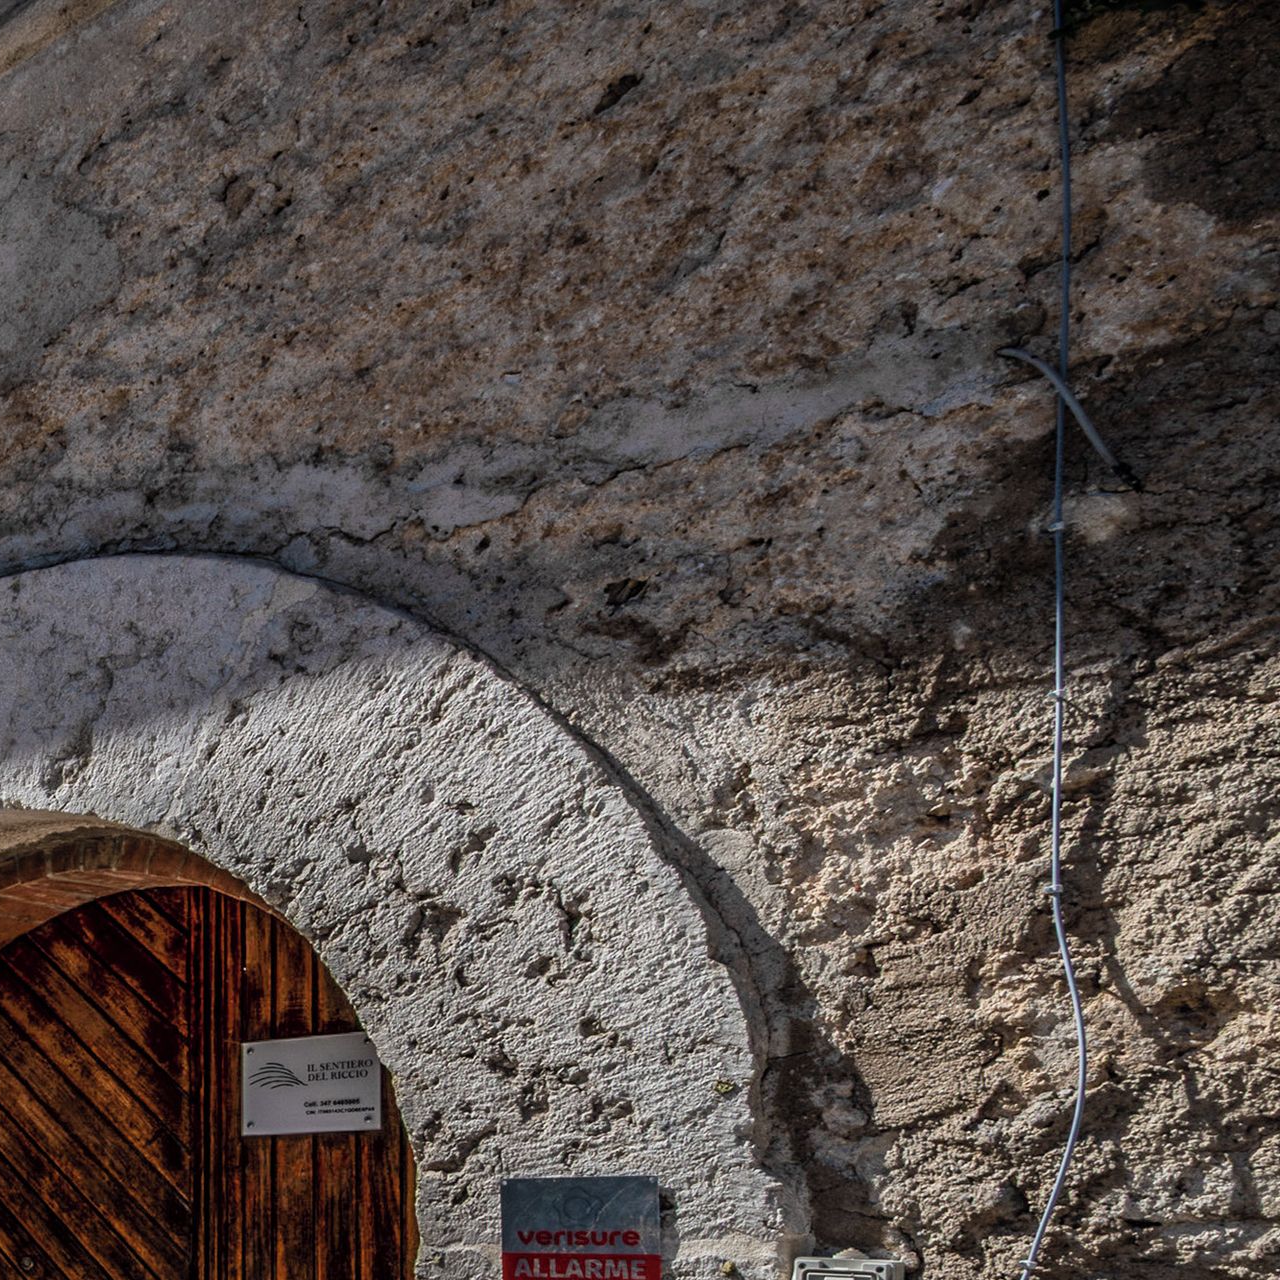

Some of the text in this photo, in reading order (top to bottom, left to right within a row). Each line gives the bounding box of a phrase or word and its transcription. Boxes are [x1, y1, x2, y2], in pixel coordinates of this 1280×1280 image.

[307, 1059, 373, 1072] IL SENTIERO
[308, 1069, 368, 1081] DEL RICCIO
[517, 1229, 640, 1246] verisure
[514, 1258, 646, 1280] ALLARME
